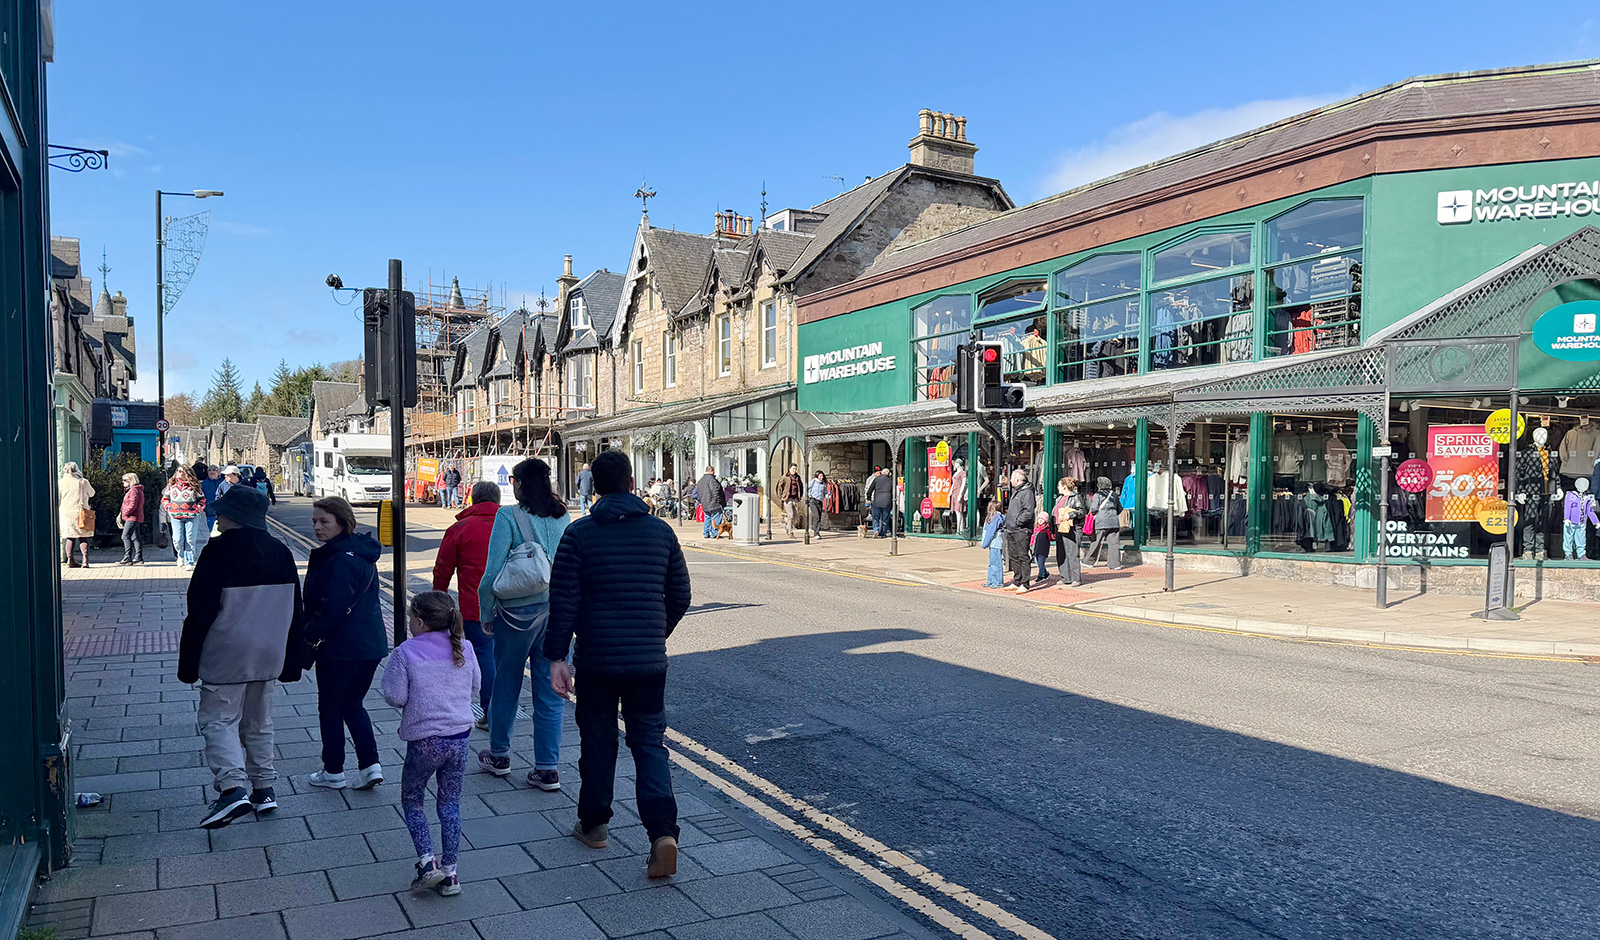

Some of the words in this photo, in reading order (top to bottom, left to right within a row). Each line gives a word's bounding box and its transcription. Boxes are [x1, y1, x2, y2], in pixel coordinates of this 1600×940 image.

[1476, 181, 1600, 204] MOUNTAI
[819, 341, 882, 366] MOUNTAIN
[819, 355, 896, 381] WAREHOUSE
[1437, 435, 1491, 445] SPRING
[1437, 446, 1490, 454] SAVINGS
[1476, 489, 1494, 498] off
